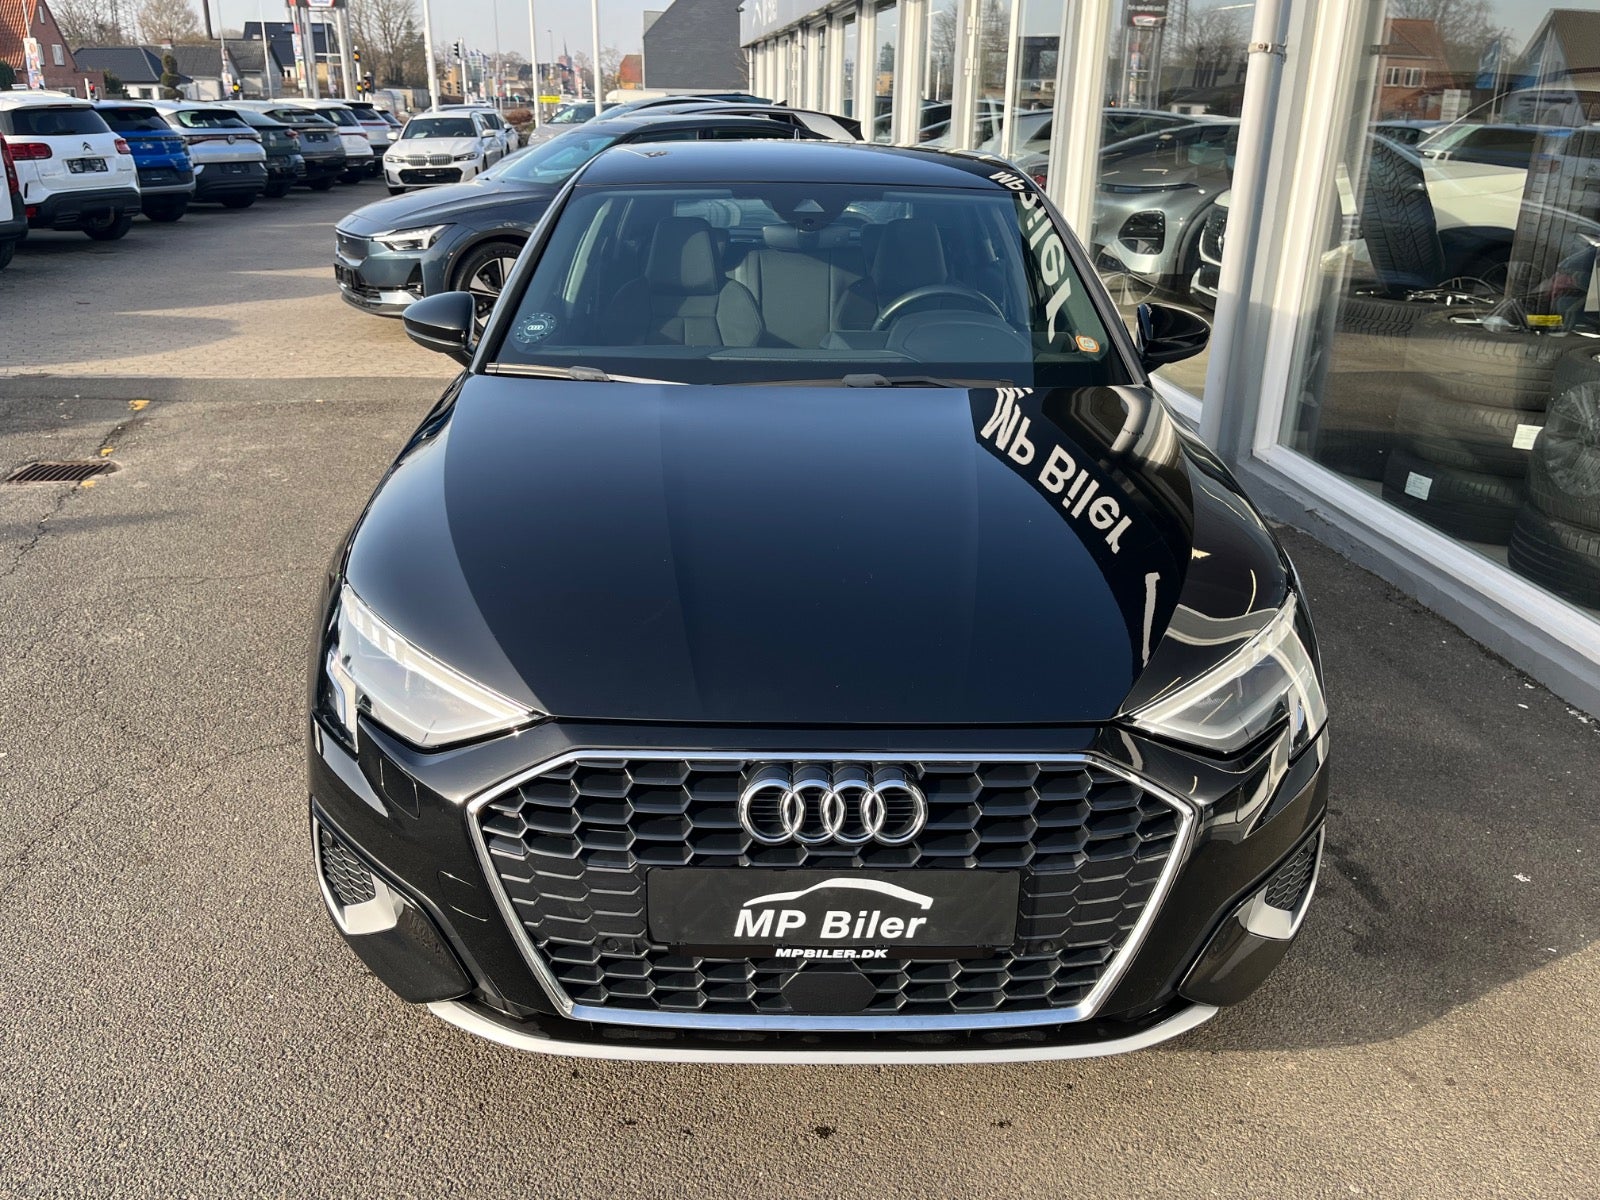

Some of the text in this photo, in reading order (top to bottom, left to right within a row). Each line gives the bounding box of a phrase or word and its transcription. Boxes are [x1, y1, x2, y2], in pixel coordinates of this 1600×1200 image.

[734, 909, 927, 939] MP Biler
[775, 948, 888, 959] MPBILER.DK
